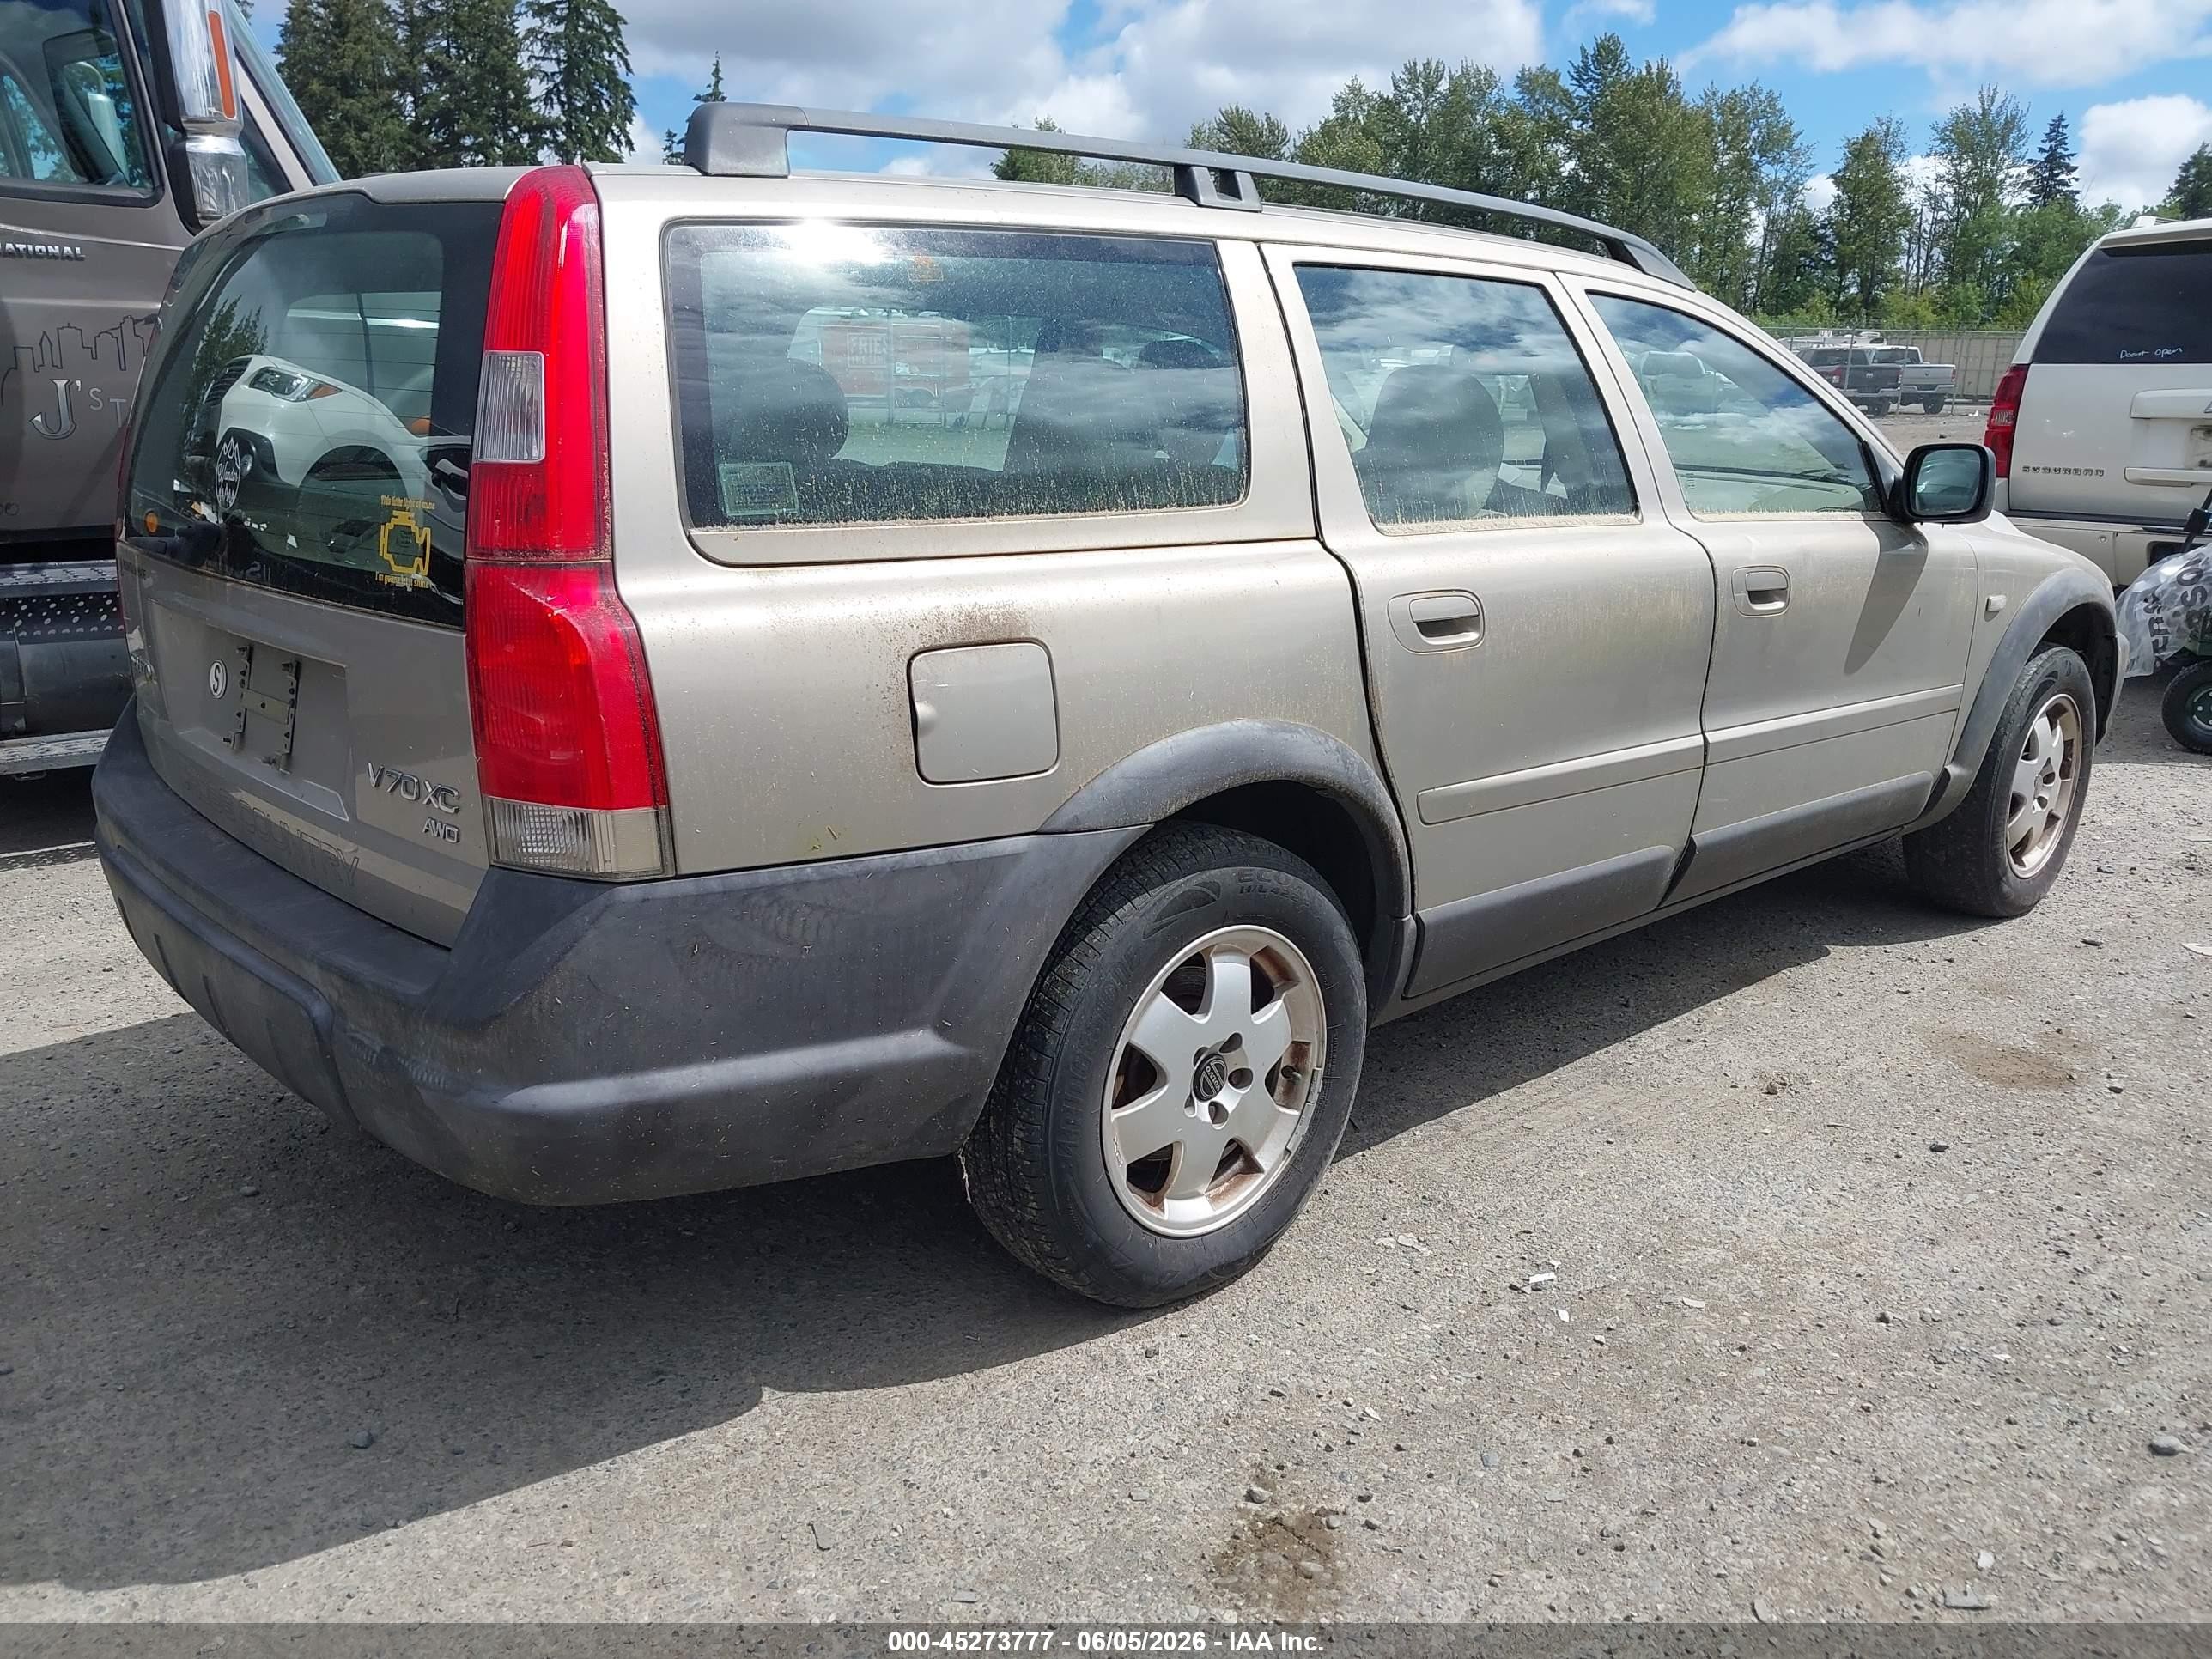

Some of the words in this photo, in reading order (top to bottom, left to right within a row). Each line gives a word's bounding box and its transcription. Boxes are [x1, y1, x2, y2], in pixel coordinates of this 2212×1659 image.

[0, 242, 86, 260] ATIONAL
[2154, 347, 2183, 358] open
[422, 817, 460, 843] AWD
[1206, 1066, 1221, 1093] VOLVO
